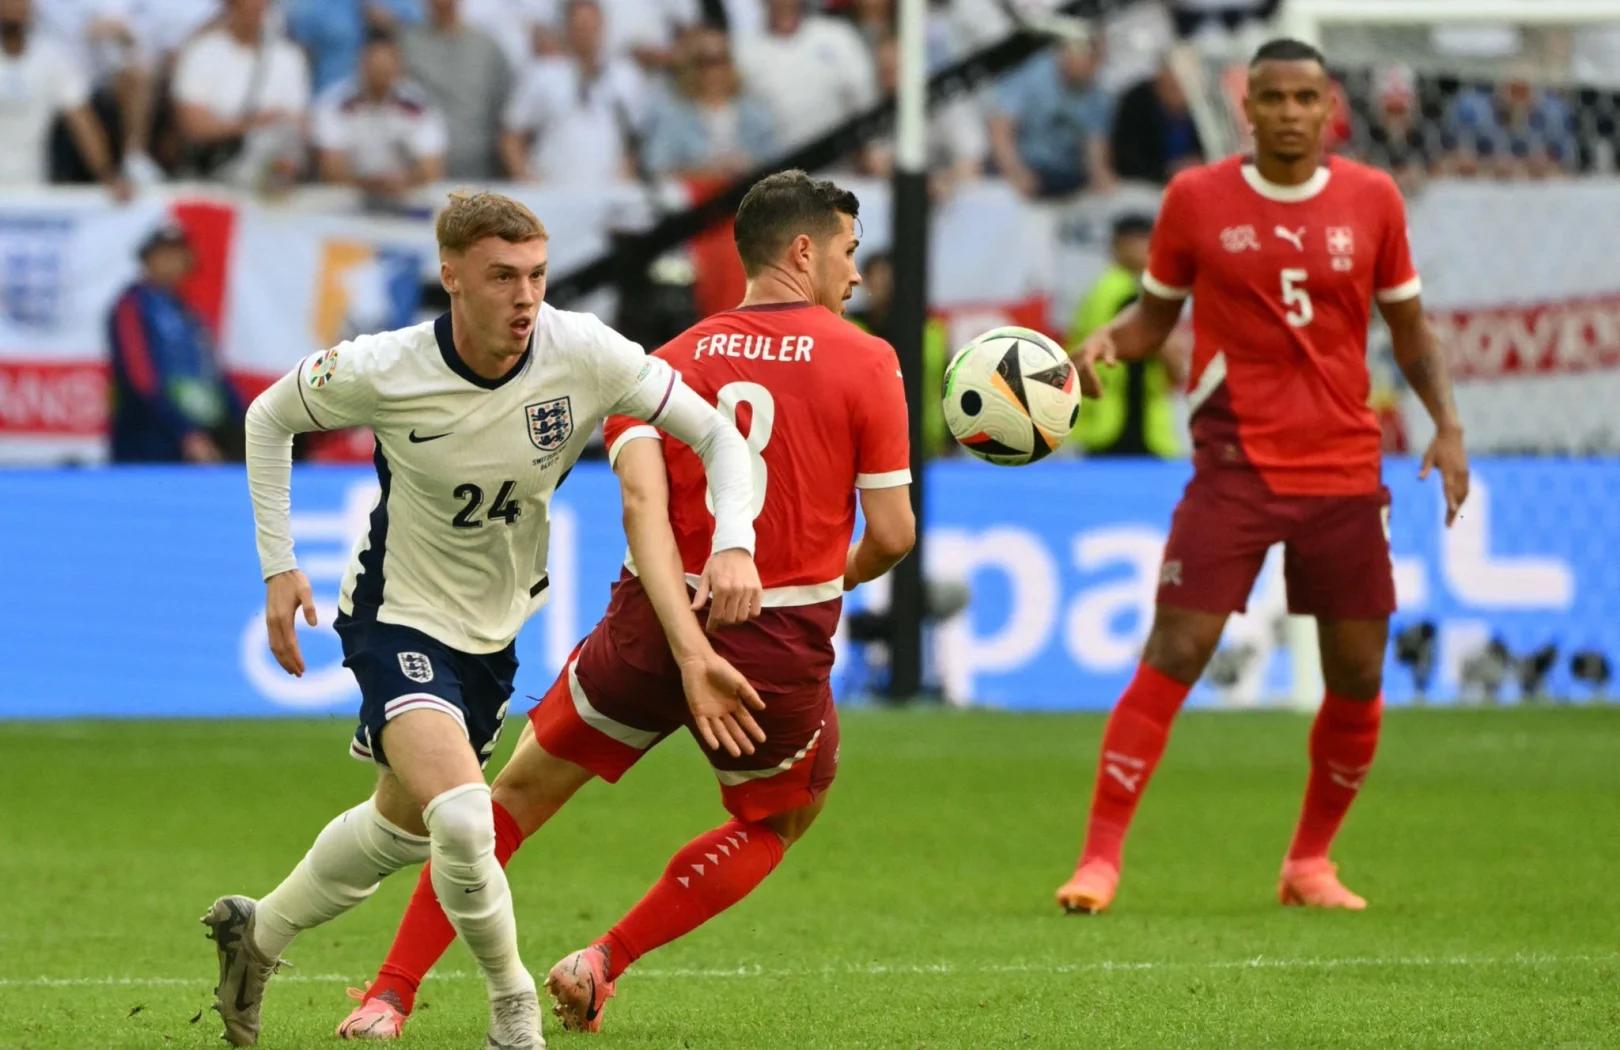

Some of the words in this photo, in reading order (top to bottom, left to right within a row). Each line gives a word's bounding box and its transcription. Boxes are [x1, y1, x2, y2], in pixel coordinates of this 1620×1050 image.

[1281, 267, 1314, 328] 5
[693, 332, 815, 363] FREULER
[704, 380, 775, 520] 8
[452, 480, 522, 529] 24
